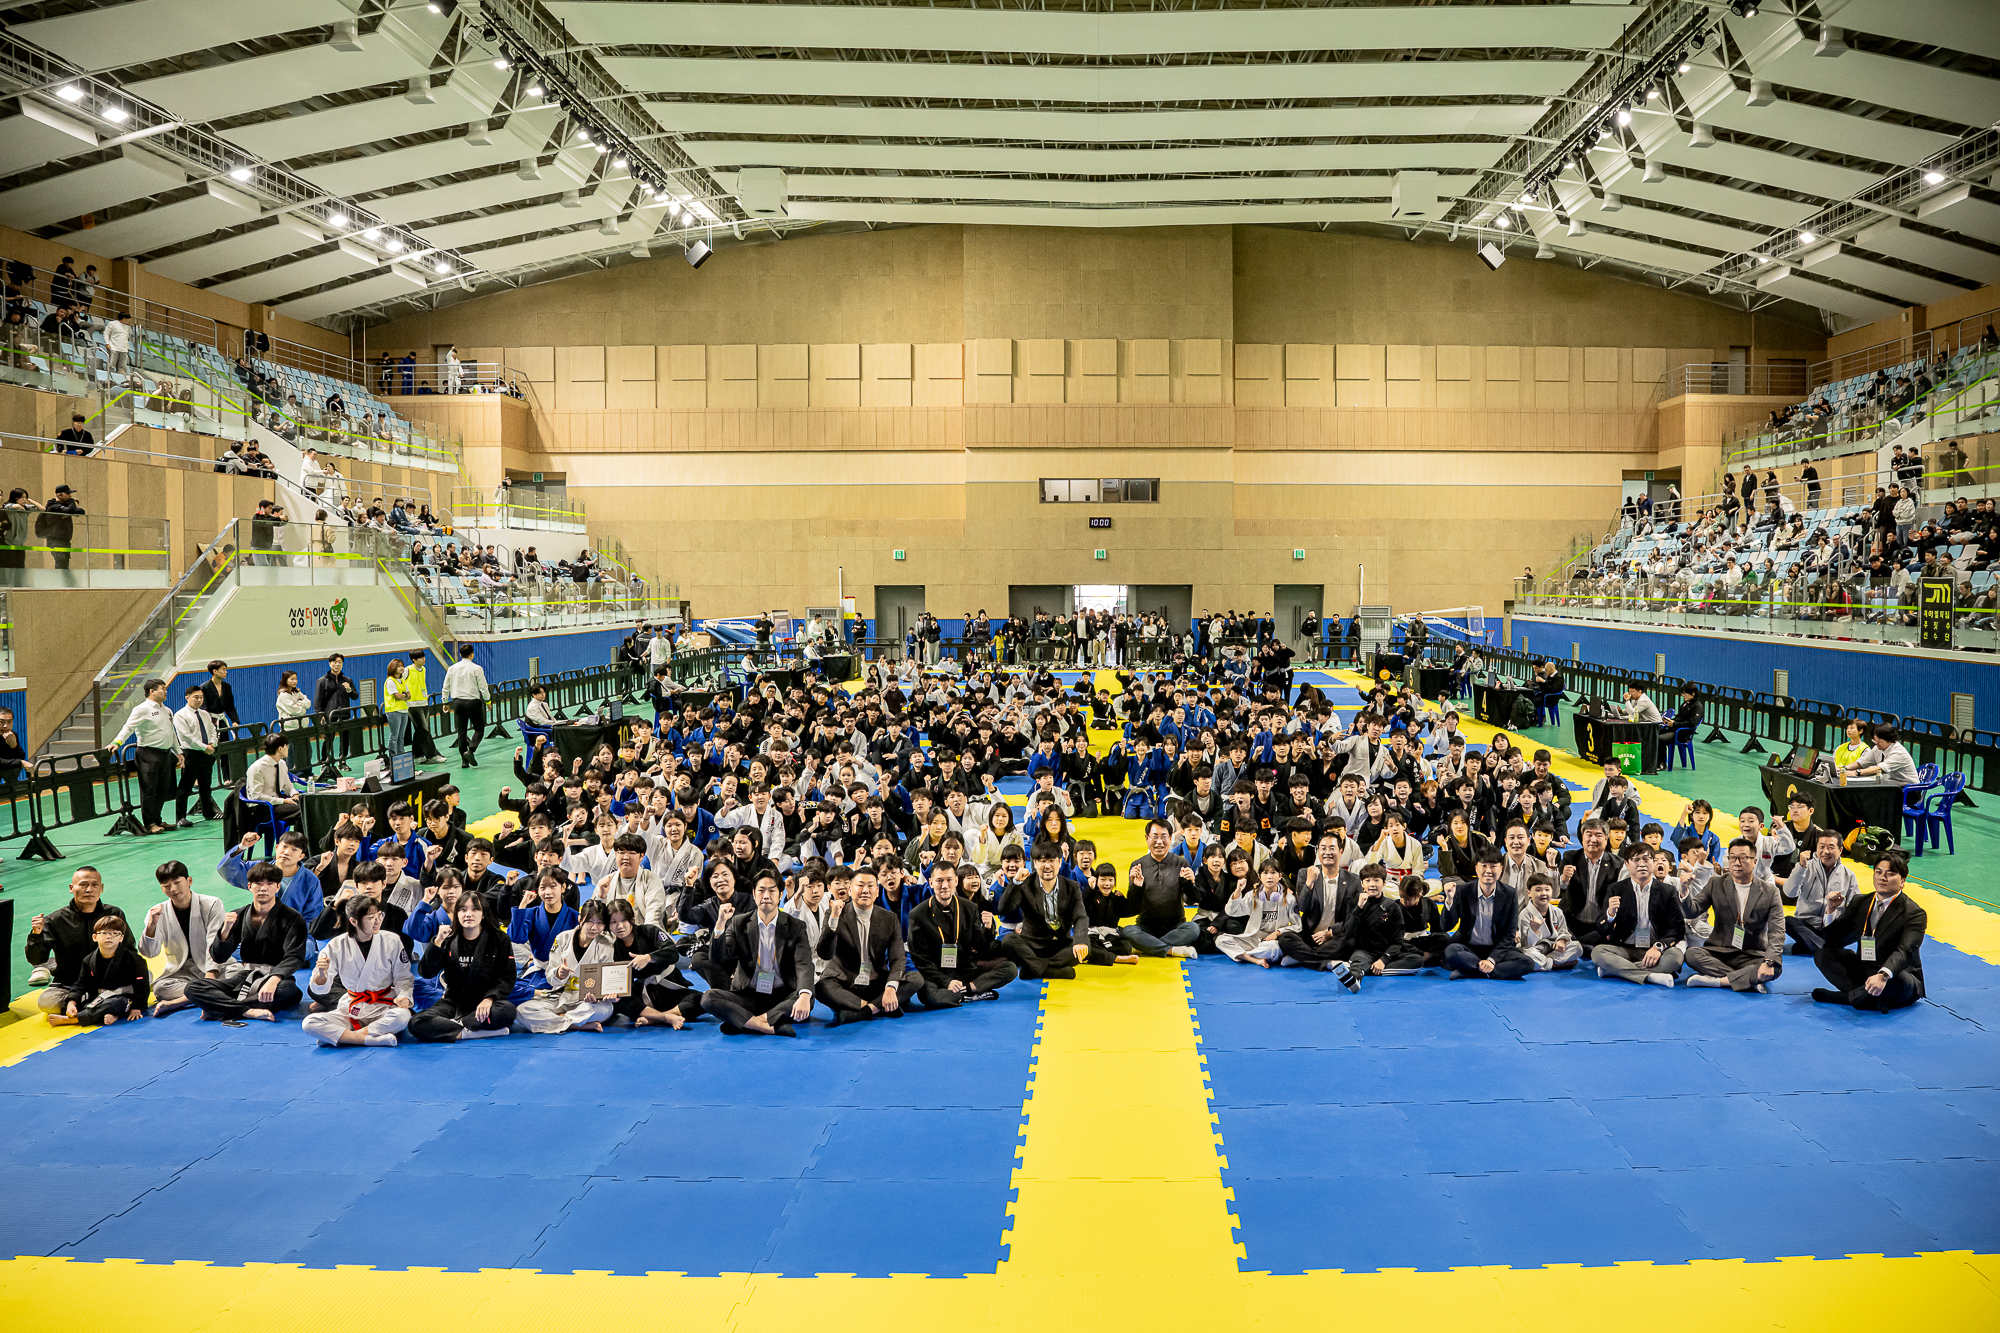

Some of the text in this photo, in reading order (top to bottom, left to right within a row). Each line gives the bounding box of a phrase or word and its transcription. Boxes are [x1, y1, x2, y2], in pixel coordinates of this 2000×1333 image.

[1481, 690, 1487, 712] 4
[617, 725, 629, 748] 10
[1587, 723, 1594, 752] 3
